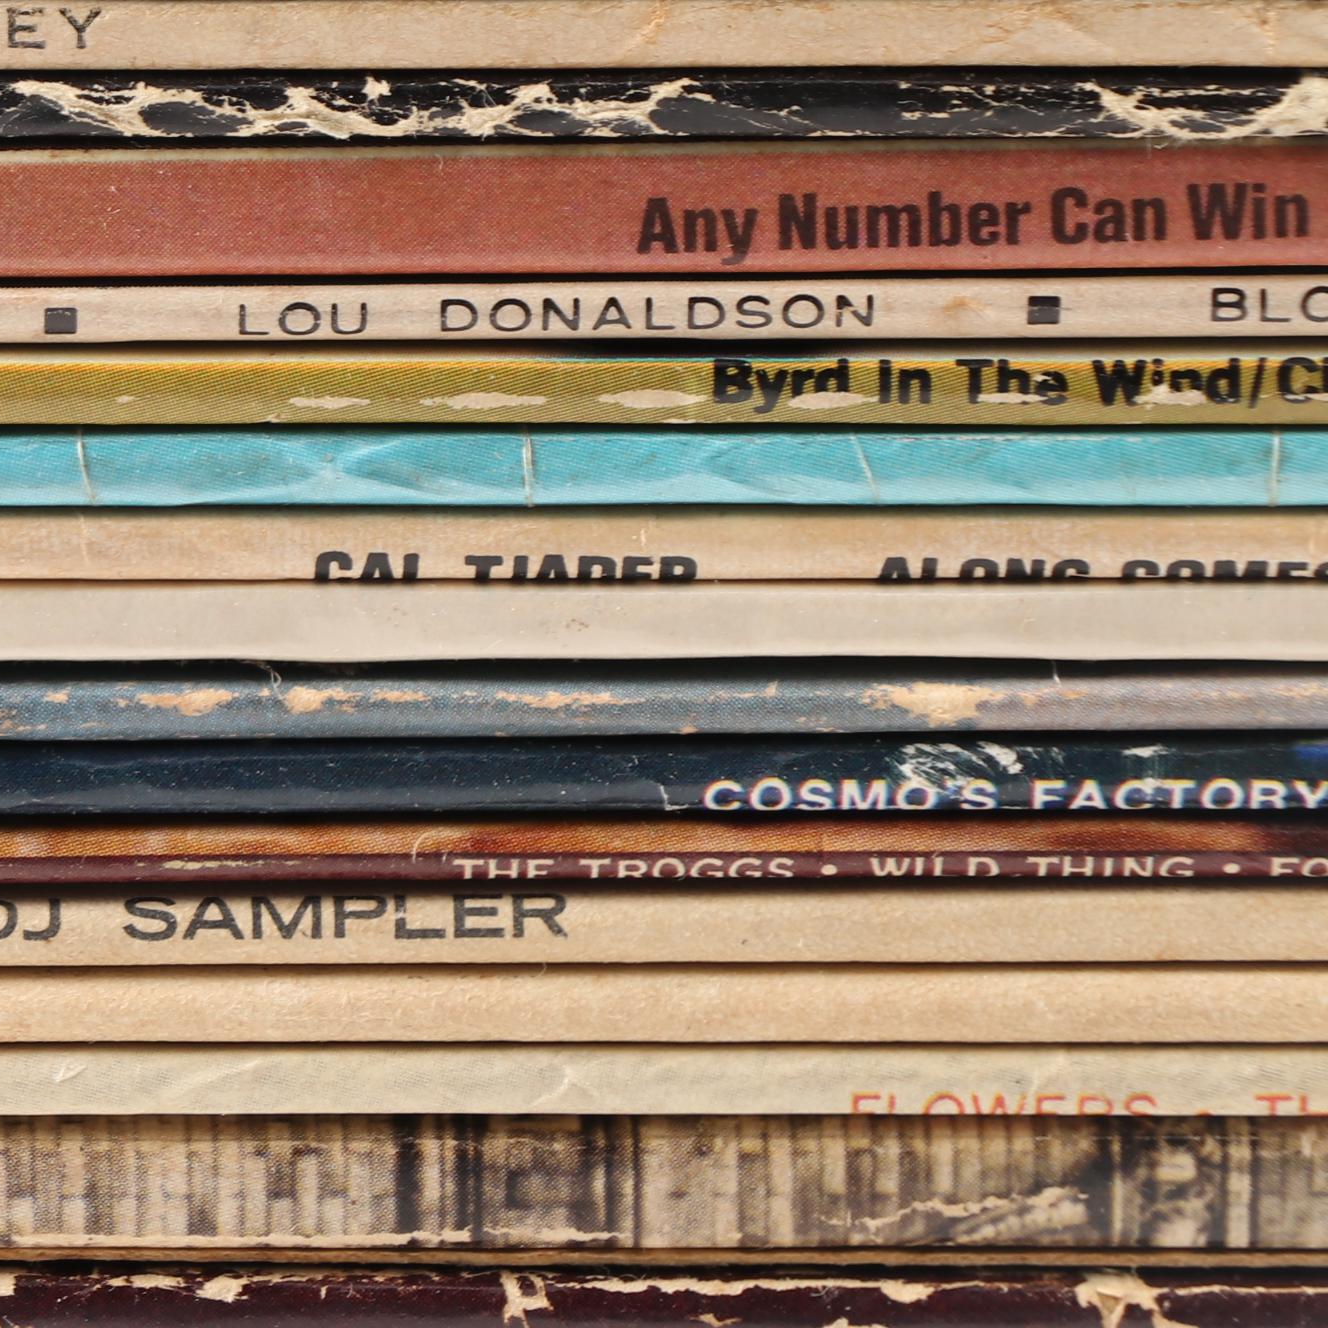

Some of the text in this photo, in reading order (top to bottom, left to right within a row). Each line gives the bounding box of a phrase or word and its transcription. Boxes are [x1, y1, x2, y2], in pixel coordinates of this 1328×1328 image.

[636, 180, 1310, 266] Any Number Can Win
[237, 294, 875, 338] LOU DONALDSON
[711, 356, 1328, 414] Byrd In The Wind/C
[701, 776, 1328, 812] COSMO'S FACTORY
[453, 857, 560, 880] THE
[578, 856, 797, 879] TROGGS
[868, 854, 1002, 878] WILD
[1025, 855, 1196, 878] THING
[121, 891, 570, 943] SAMPLER
